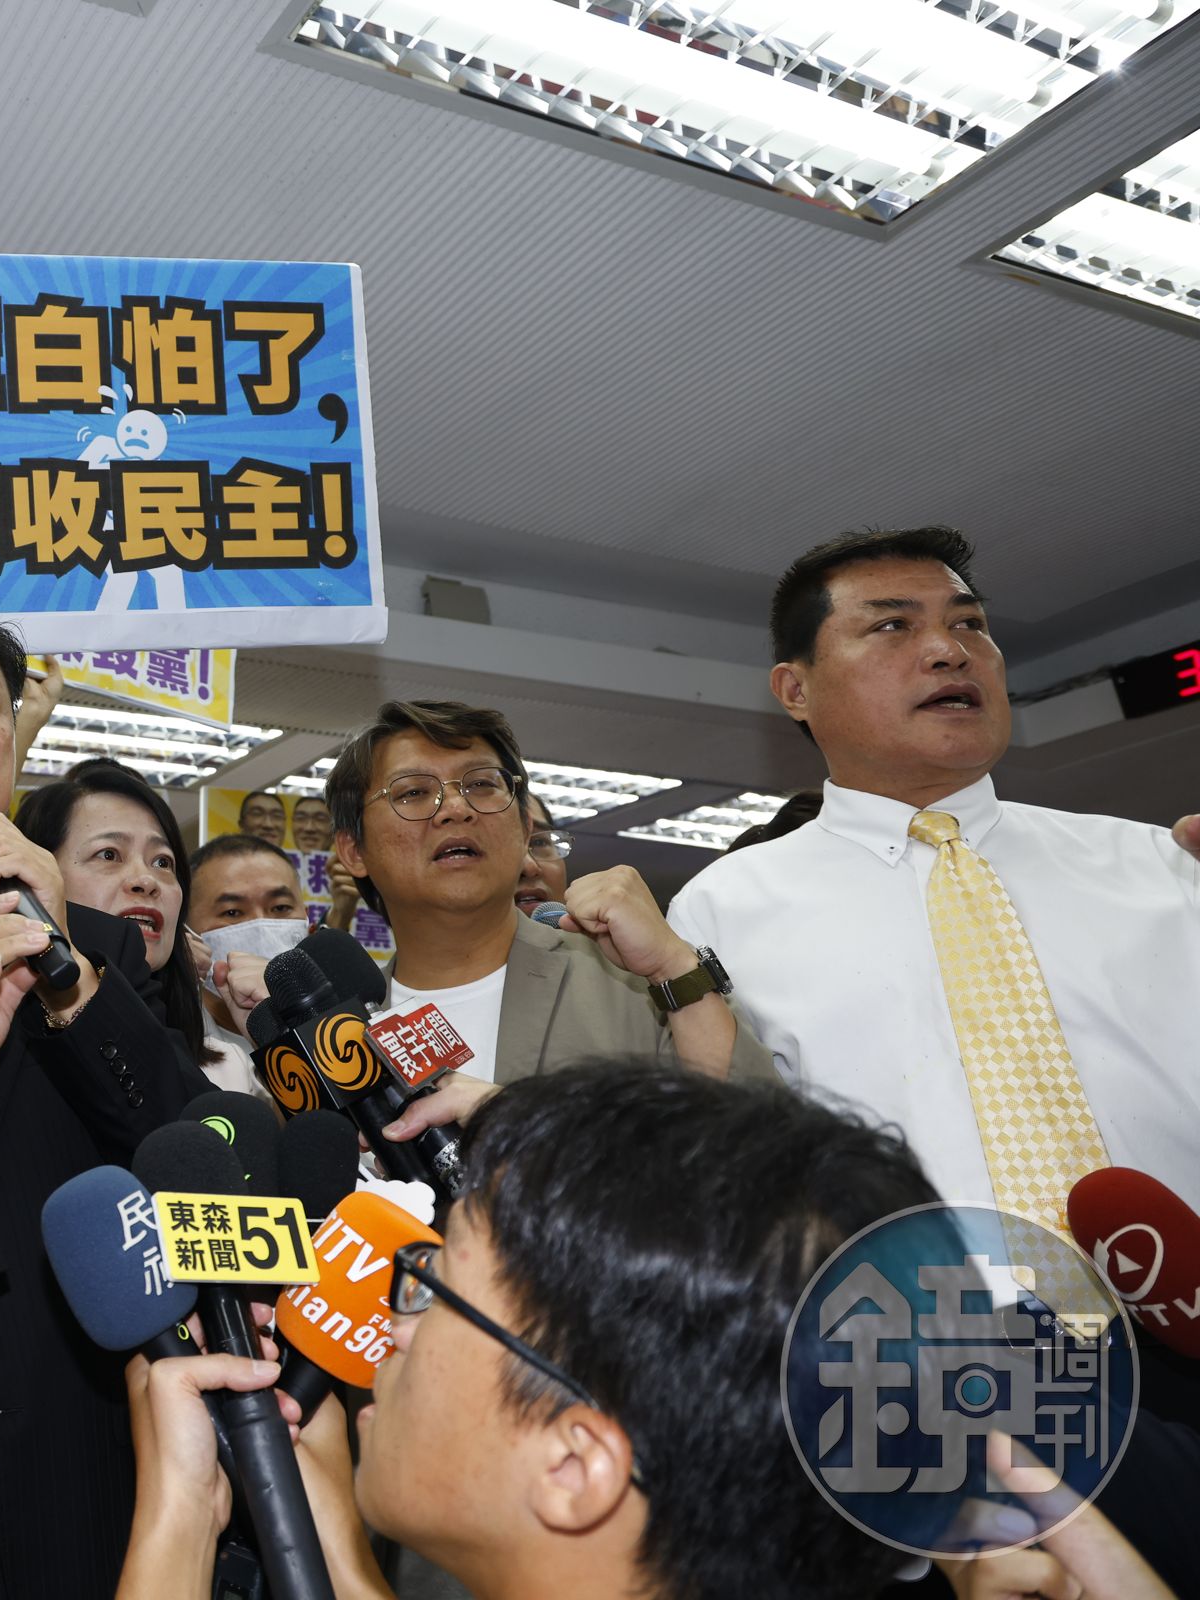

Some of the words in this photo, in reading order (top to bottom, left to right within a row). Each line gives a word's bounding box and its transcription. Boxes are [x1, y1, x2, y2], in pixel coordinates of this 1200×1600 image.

[1173, 648, 1200, 697] 3
[377, 1010, 463, 1080] 寰宇新聞
[166, 1200, 233, 1234] 東森
[238, 1206, 309, 1270] 51
[175, 1238, 241, 1272] 新聞
[312, 1210, 390, 1283] ITV
